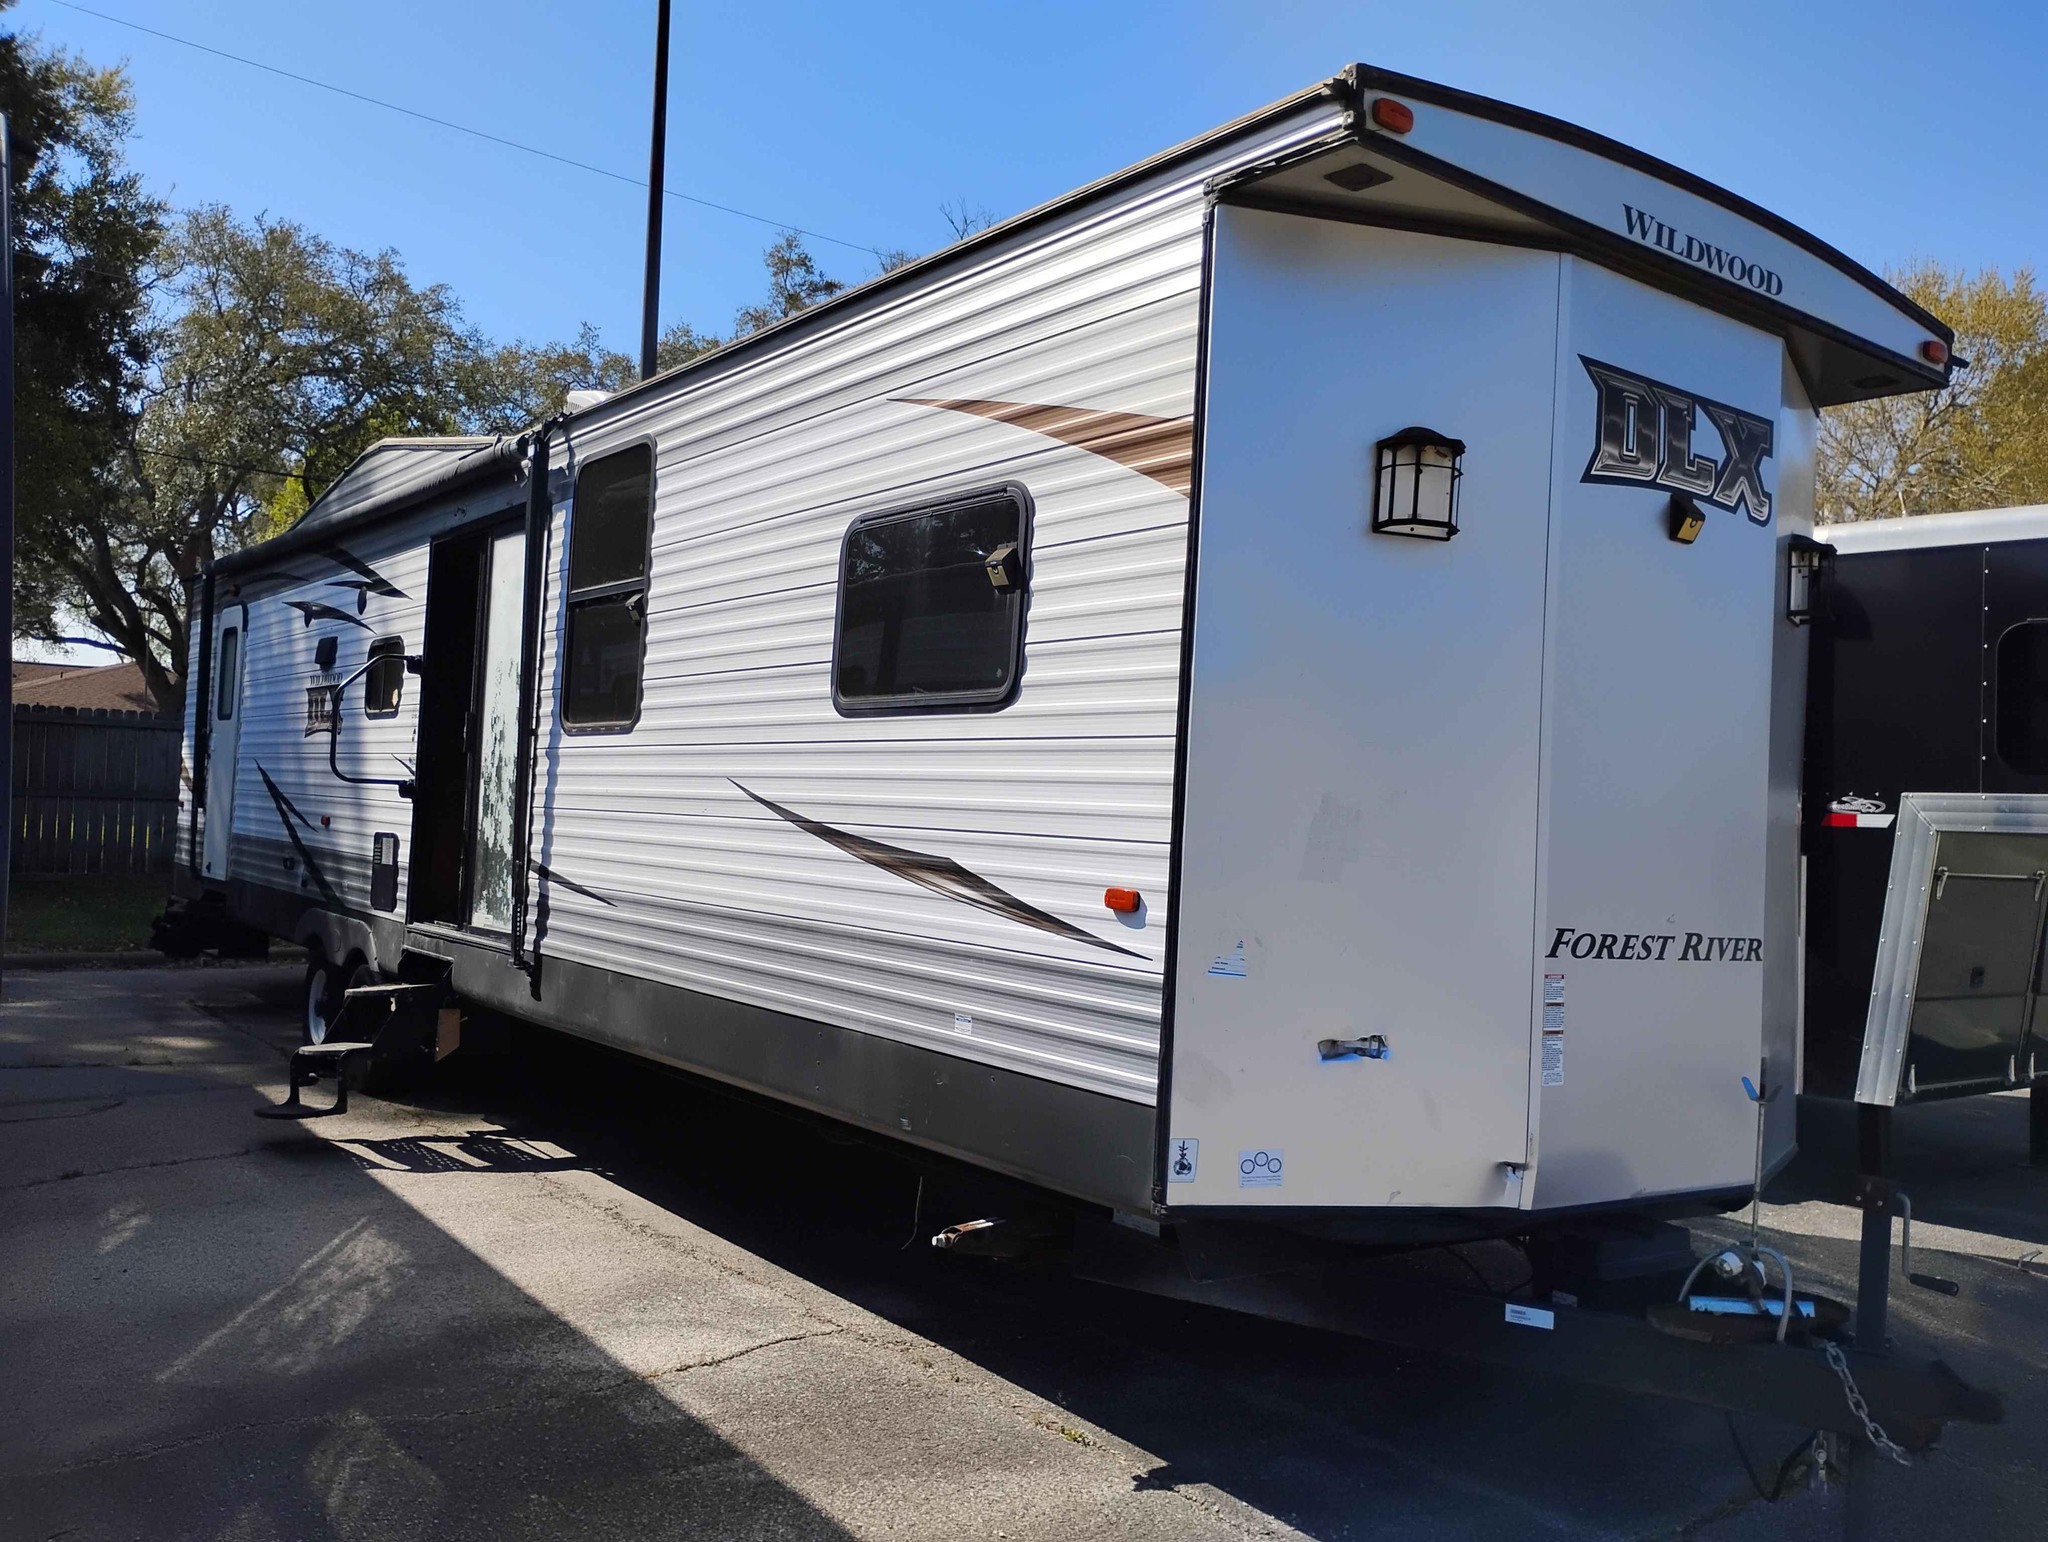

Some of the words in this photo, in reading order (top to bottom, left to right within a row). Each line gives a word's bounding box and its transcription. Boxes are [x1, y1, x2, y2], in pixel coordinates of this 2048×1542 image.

[1623, 203, 1783, 296] WILDWOOD
[1577, 354, 1774, 526] DLX
[1545, 928, 1676, 961] FOREST
[1679, 932, 1763, 962] RIVER
